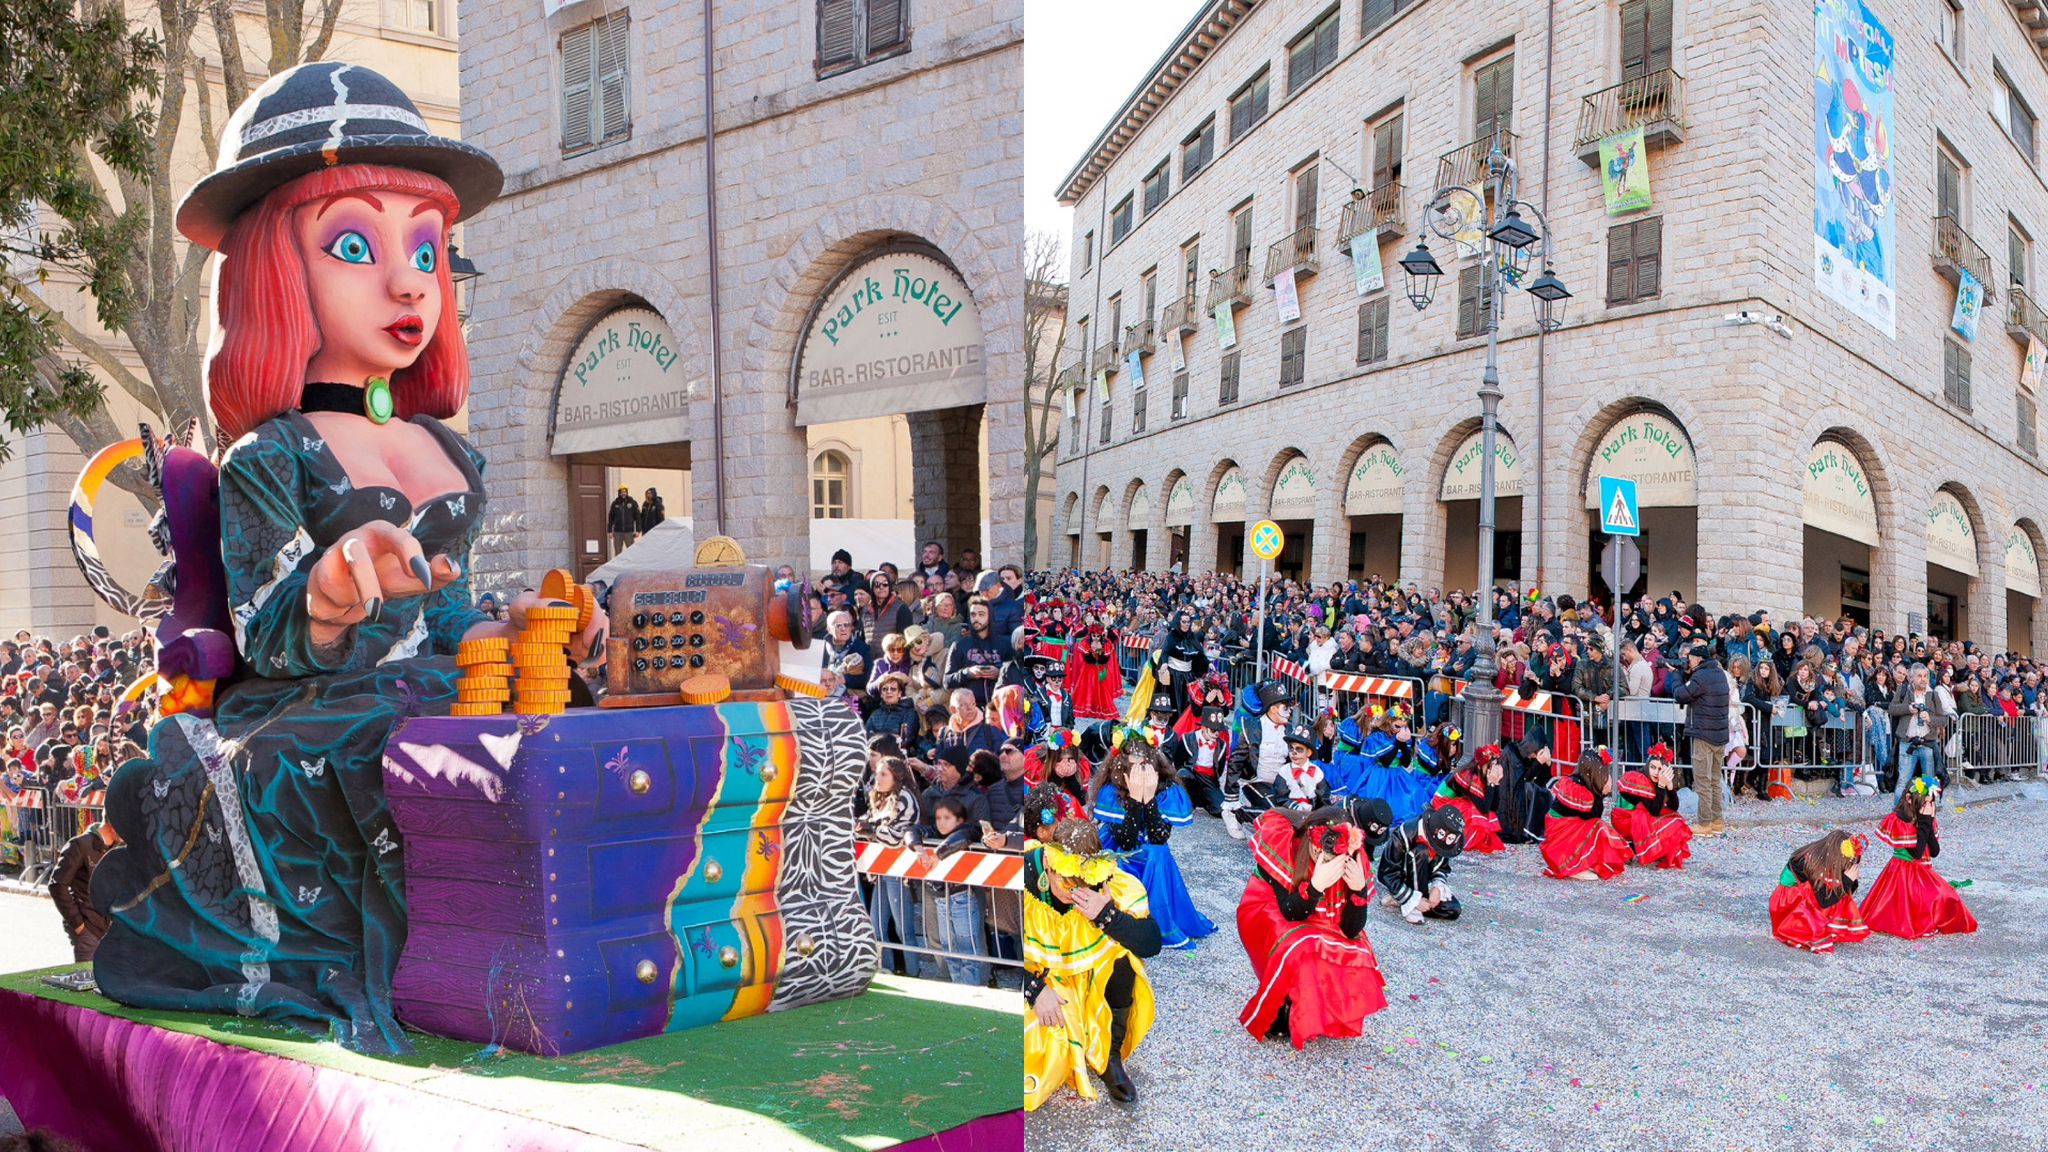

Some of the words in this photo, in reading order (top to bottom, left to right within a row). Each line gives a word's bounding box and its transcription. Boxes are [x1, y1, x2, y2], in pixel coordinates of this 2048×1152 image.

[821, 277, 883, 346] Park
[892, 268, 963, 327] Hotel
[878, 311, 898, 325] ESIT
[574, 328, 621, 388] Park
[627, 322, 678, 374] Hotel
[616, 358, 631, 370] ESIT
[809, 343, 979, 388] BAR-RISTORANTE
[564, 390, 688, 422] BAR-RISTORANTE
[1456, 441, 1483, 474] Park
[1495, 443, 1516, 470] otel
[1601, 425, 1639, 464] Park
[1644, 422, 1683, 459] Hotel
[1355, 452, 1378, 481] Park
[1808, 450, 1838, 481] Park
[1841, 454, 1868, 497] Hotel
[654, 614, 663, 623] 10
[635, 639, 645, 649] 2
[653, 639, 664, 647] 20
[636, 659, 646, 670] 5
[653, 659, 664, 667] 50
[671, 658, 684, 666] 500
